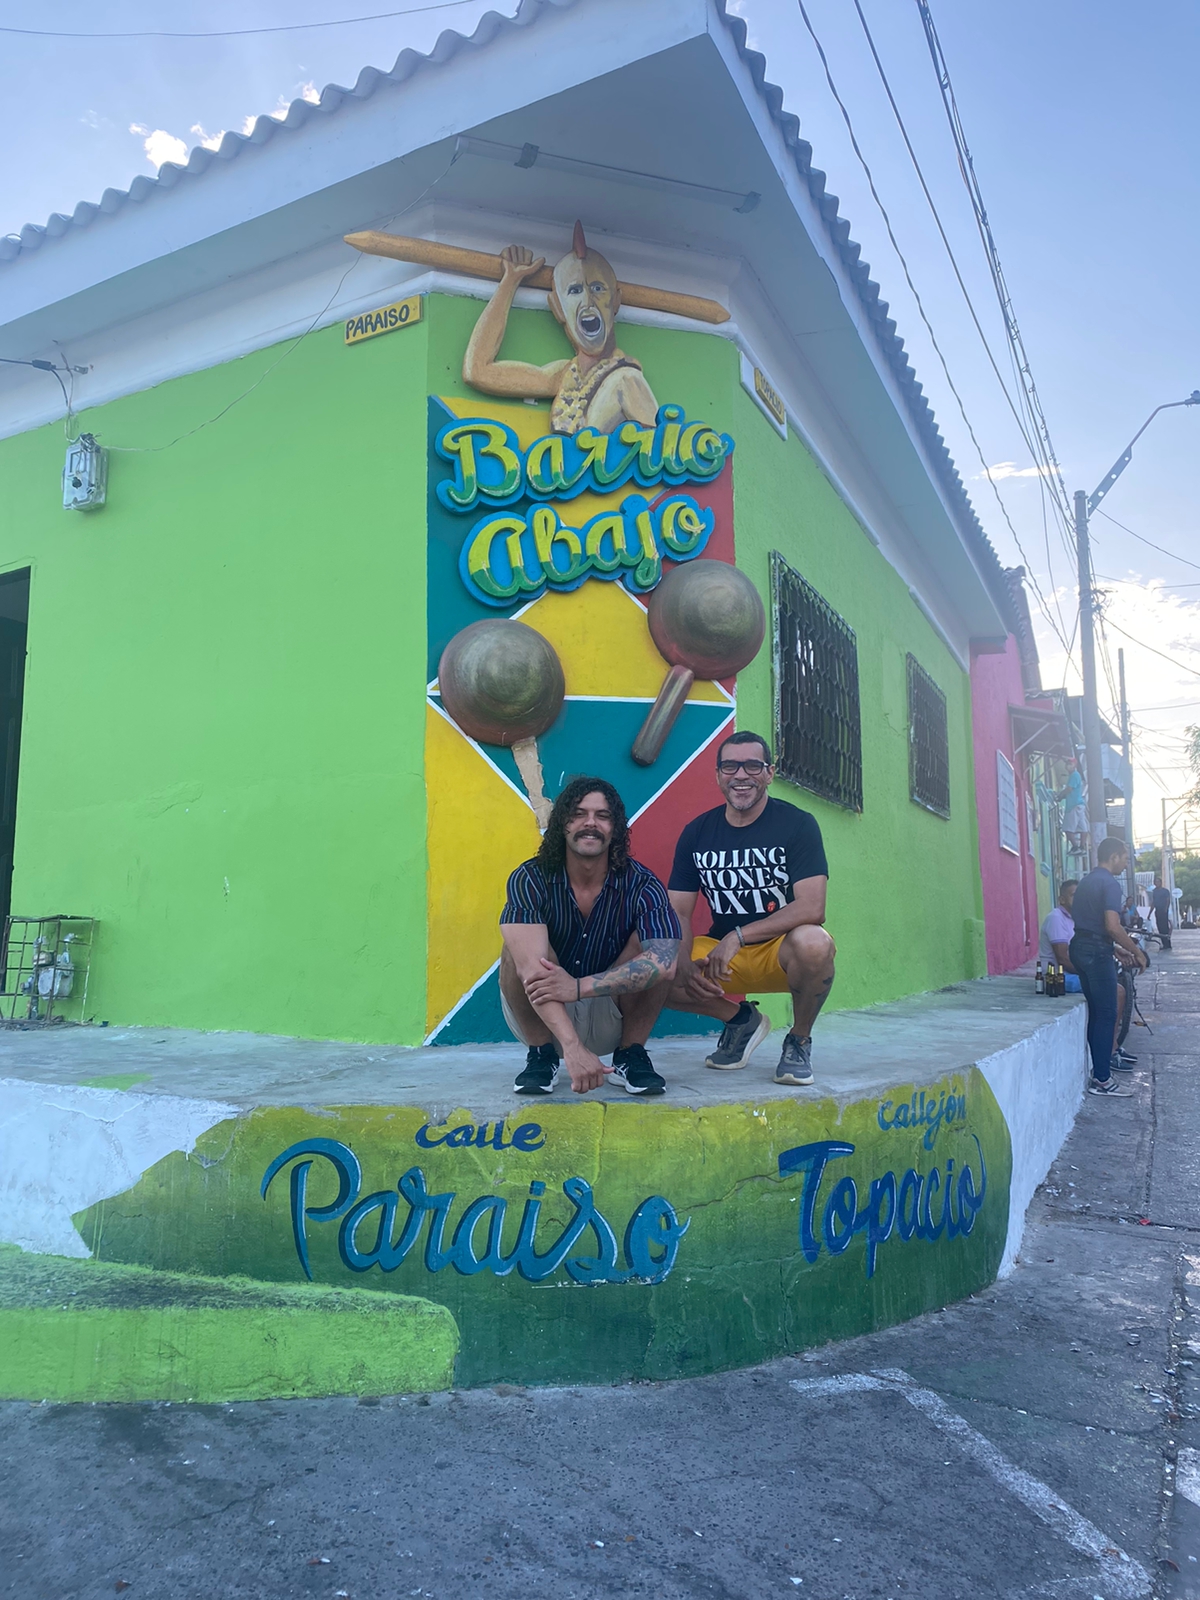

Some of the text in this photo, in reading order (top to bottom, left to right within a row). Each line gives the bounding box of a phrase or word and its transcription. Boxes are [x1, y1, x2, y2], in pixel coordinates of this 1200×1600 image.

[346, 304, 410, 340] PARAISO
[438, 404, 732, 509] Barrio
[463, 498, 711, 602] Abajo
[692, 847, 787, 869] ROLLING
[699, 866, 790, 890] STONES
[260, 1136, 692, 1286] Paraiso
[778, 1133, 987, 1279] Topacio
